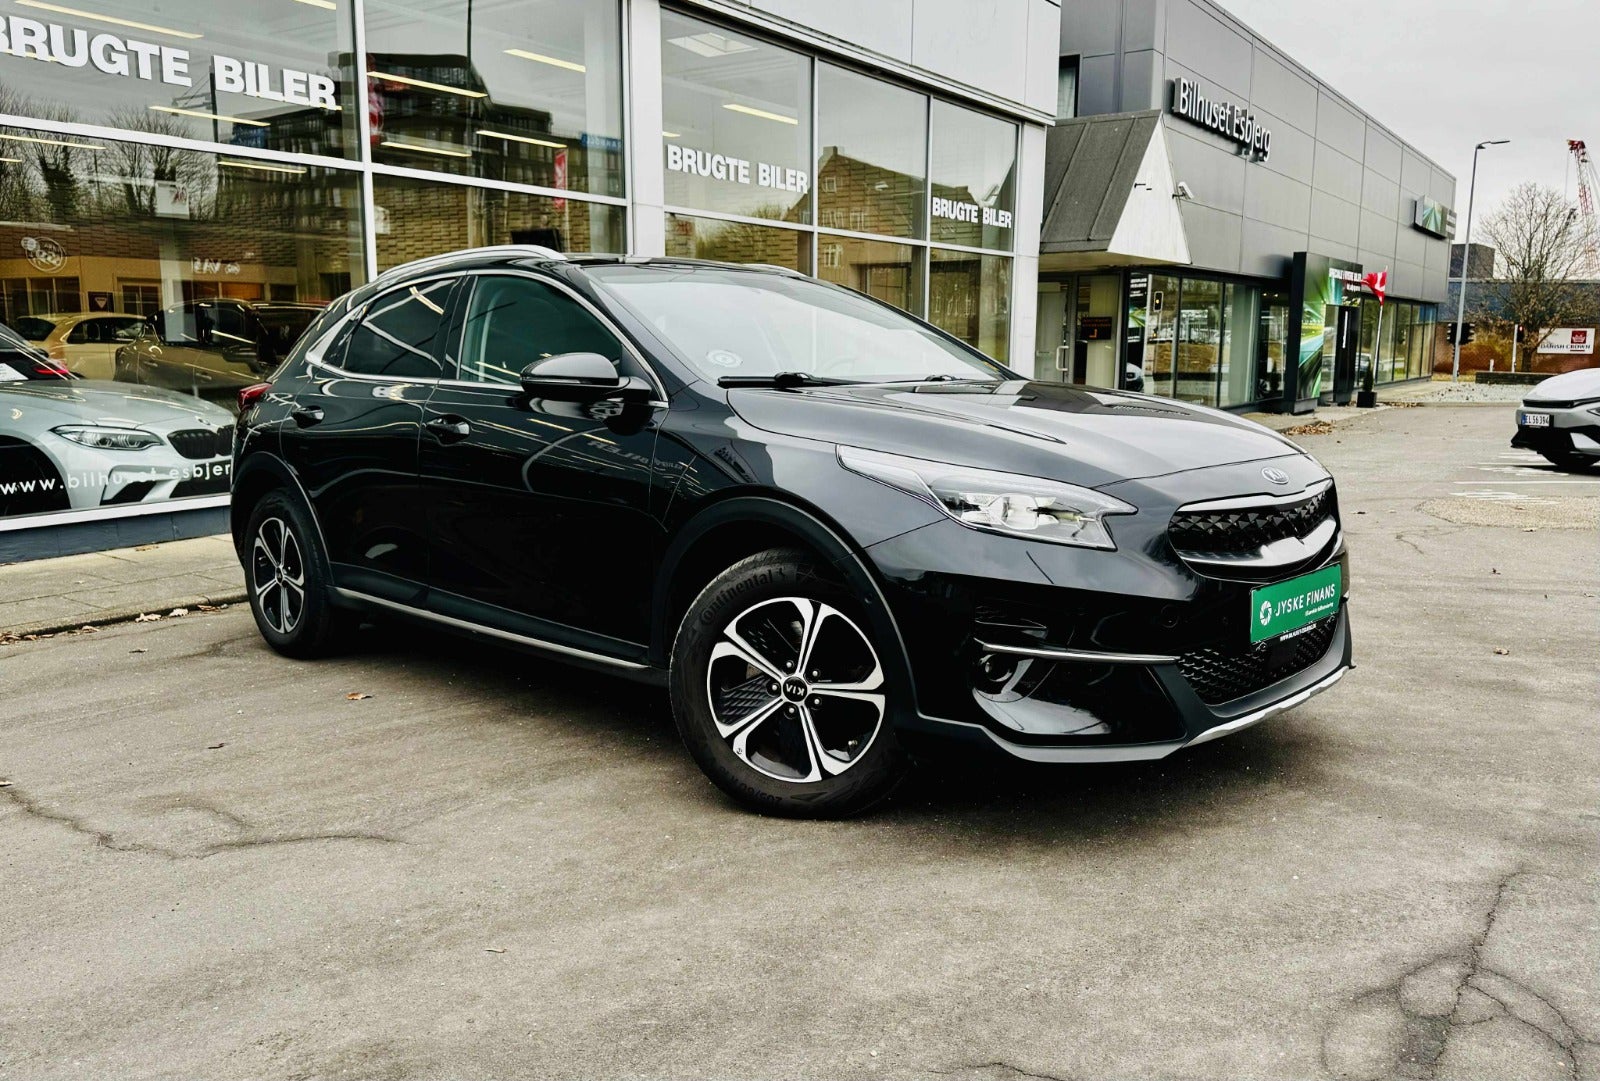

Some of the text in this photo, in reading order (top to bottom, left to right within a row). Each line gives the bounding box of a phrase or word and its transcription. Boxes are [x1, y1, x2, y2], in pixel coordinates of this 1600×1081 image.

[0, 15, 337, 110] RUGTE BILER
[1179, 77, 1271, 161] Bilhuset Esbjerg
[667, 143, 808, 194] BRUGTE BILER
[932, 196, 1012, 228] BRUGTE BILER
[1275, 595, 1305, 617] JYSKE
[1306, 583, 1335, 606] FINANS
[785, 682, 805, 696] KIA
